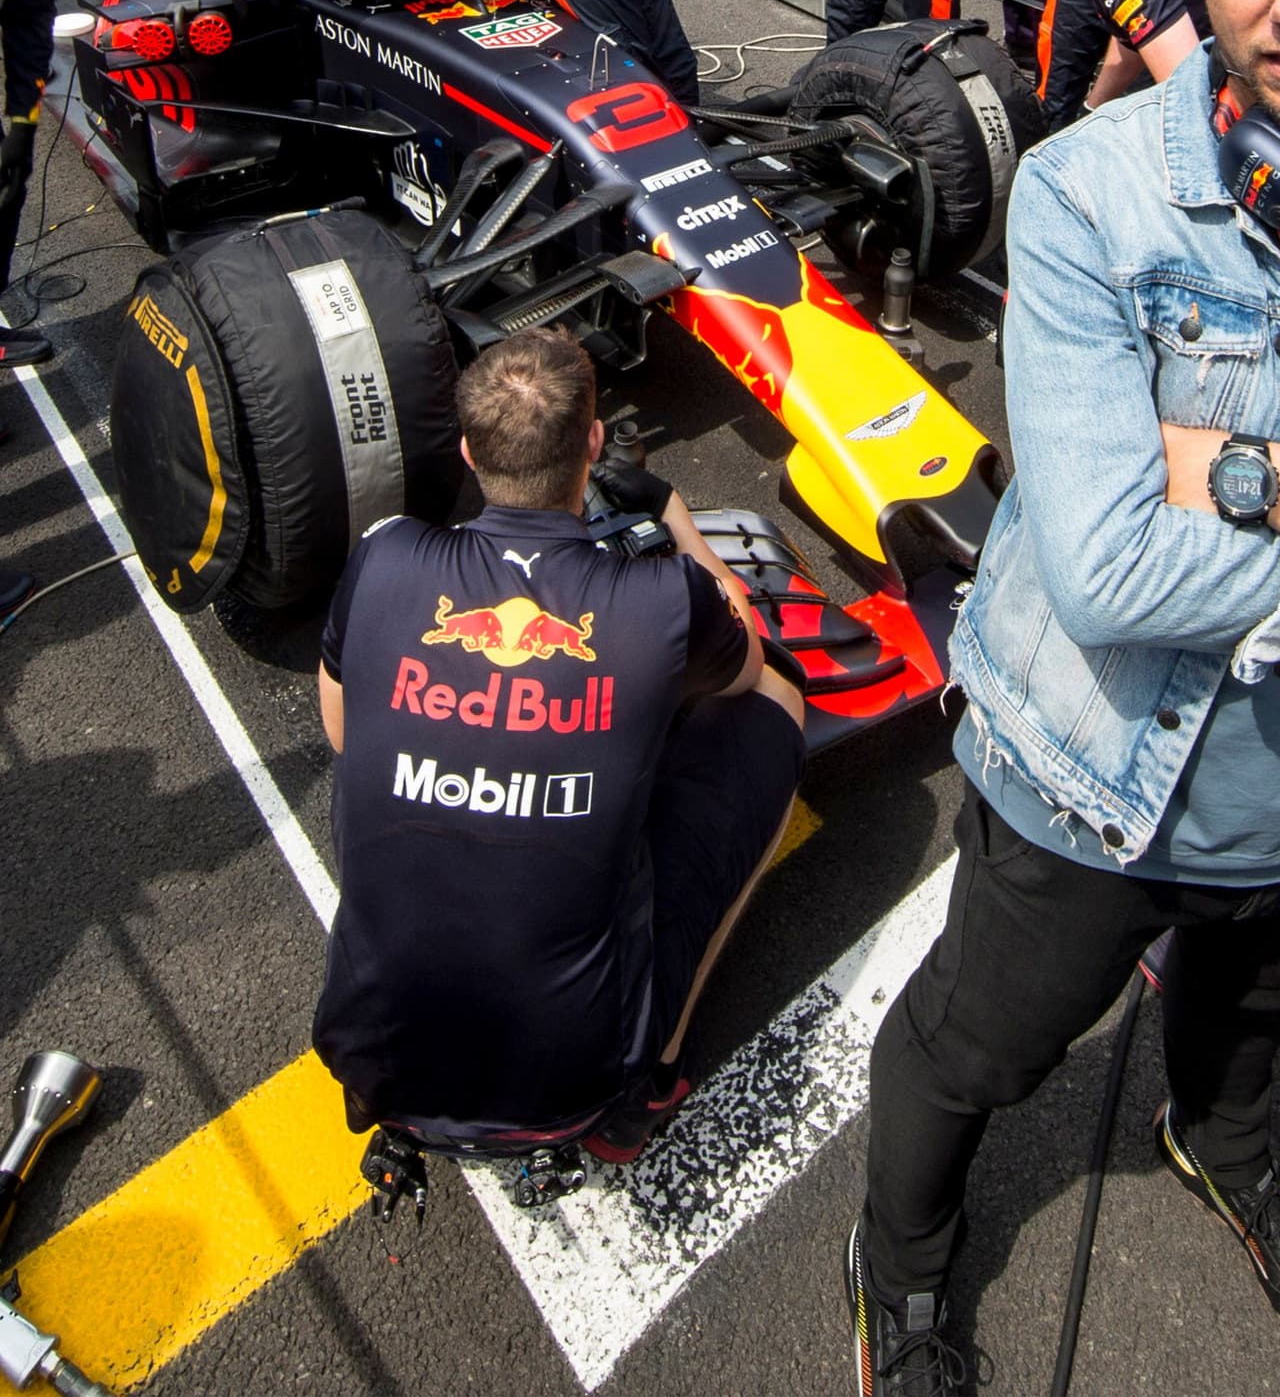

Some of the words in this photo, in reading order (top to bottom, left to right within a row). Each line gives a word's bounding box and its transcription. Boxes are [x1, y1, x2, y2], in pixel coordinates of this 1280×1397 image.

[470, 15, 540, 35] TAG
[482, 24, 555, 47] HEUER
[314, 14, 372, 58] ASTON
[377, 42, 442, 96] MARTIN
[566, 82, 691, 153] 3
[640, 158, 713, 193] PIRELLI
[705, 237, 762, 269] Mobil
[322, 283, 335, 300] TO
[330, 300, 346, 323] LAP
[340, 285, 358, 313] GRID
[133, 292, 189, 369] PIRELLI
[341, 372, 369, 445] Front
[360, 372, 388, 442] Right
[390, 656, 503, 729] Red
[506, 675, 614, 733] Bull
[392, 752, 538, 819] Mobil
